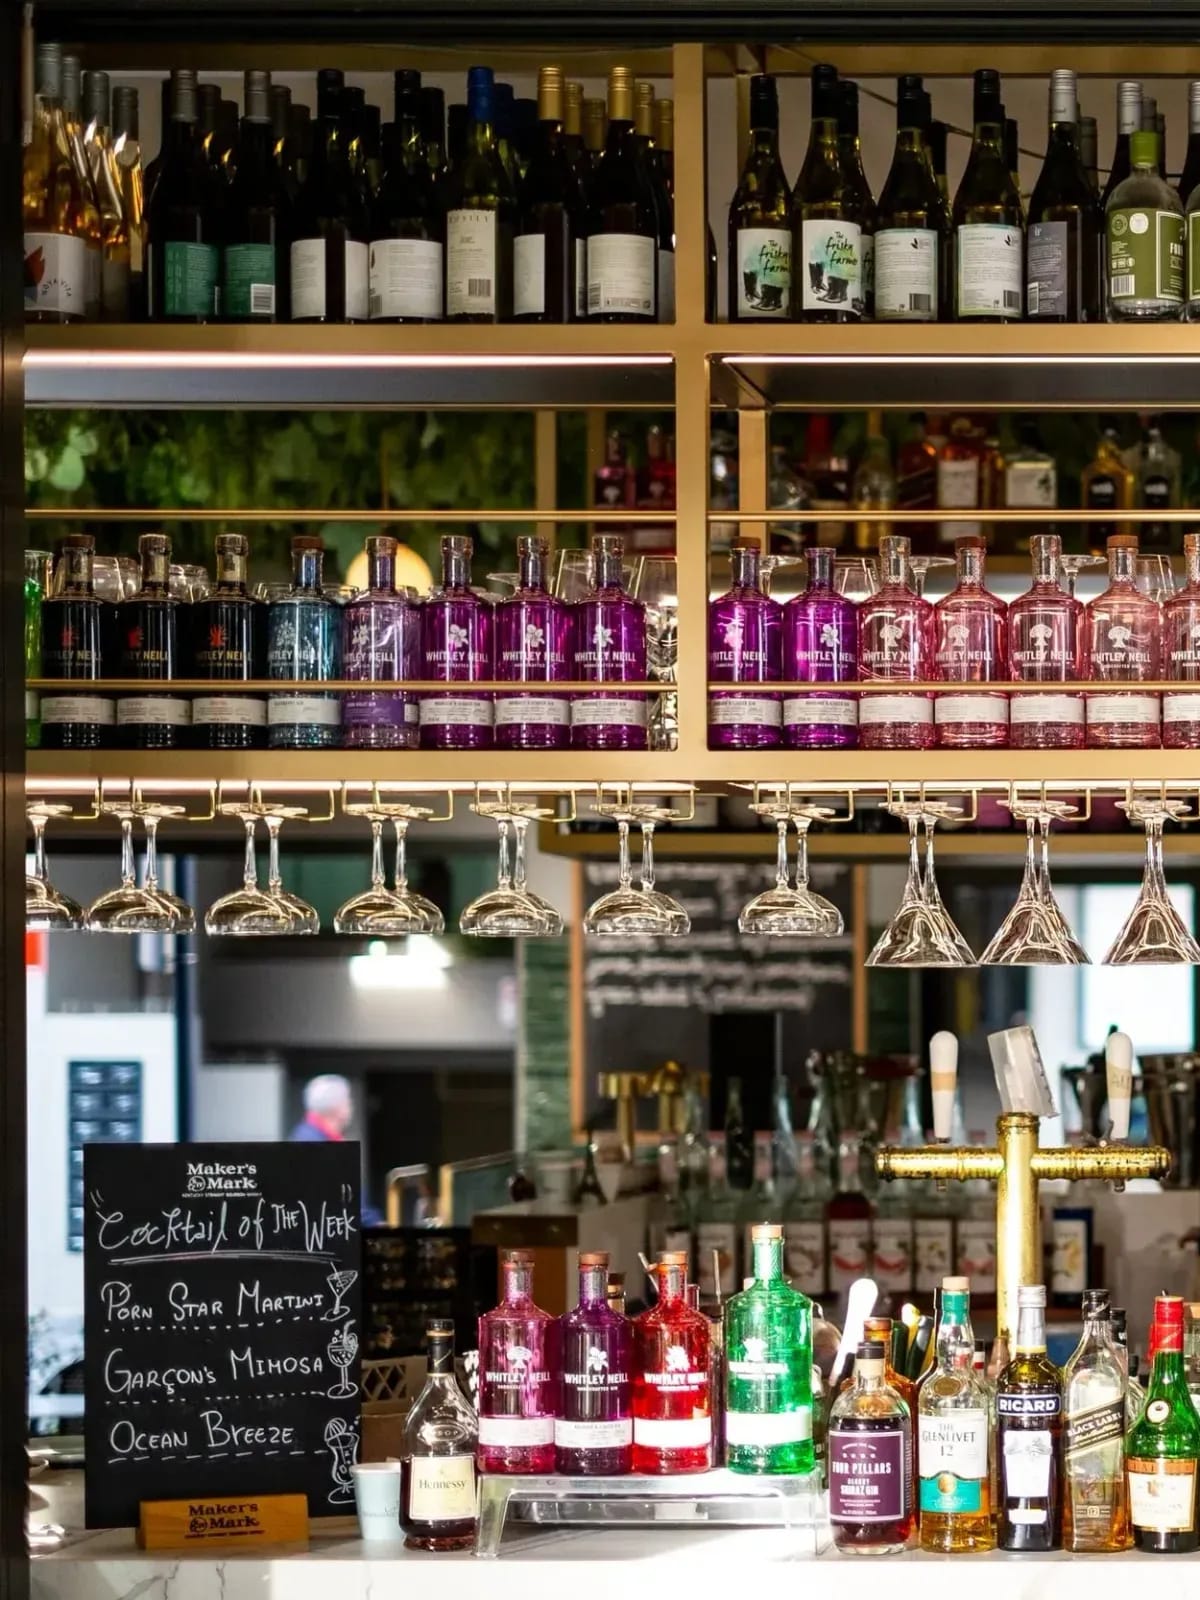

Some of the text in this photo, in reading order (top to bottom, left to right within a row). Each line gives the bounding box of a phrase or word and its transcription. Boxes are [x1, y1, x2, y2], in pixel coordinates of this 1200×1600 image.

[826, 236, 854, 255] frisky
[830, 251, 858, 269] farme
[763, 259, 789, 276] farm
[426, 651, 465, 661] WHITLEY
[503, 651, 541, 661] WHITLEY
[575, 651, 636, 662] WHITLEY NEILL
[743, 651, 767, 661] NEILL
[796, 651, 835, 661] WHITLEY
[968, 650, 992, 661] NEILL
[1050, 650, 1074, 661] NEILL
[1129, 652, 1151, 663] NEILL
[186, 1162, 257, 1175] Maker's
[206, 1176, 257, 1190] Mark
[238, 1198, 265, 1250] of
[271, 1203, 299, 1233] THE
[101, 1280, 324, 1321] PORN STAR MARTINI
[230, 1346, 323, 1380] MIMOSA
[485, 1371, 551, 1382] WHITLEY NEILL
[565, 1372, 629, 1384] WHITLEY NEILL
[999, 1399, 1056, 1413] RICARD
[1067, 1421, 1095, 1437] BLACK
[1095, 1411, 1122, 1427] LABEL
[110, 1420, 188, 1453] OCEAN
[922, 1431, 977, 1443] GLENLIVET
[940, 1445, 954, 1457] 12
[832, 1461, 891, 1474] FOUR PILLARS
[419, 1479, 467, 1489] Hennessy
[188, 1504, 259, 1516] Maker's
[209, 1516, 259, 1529] Mark
